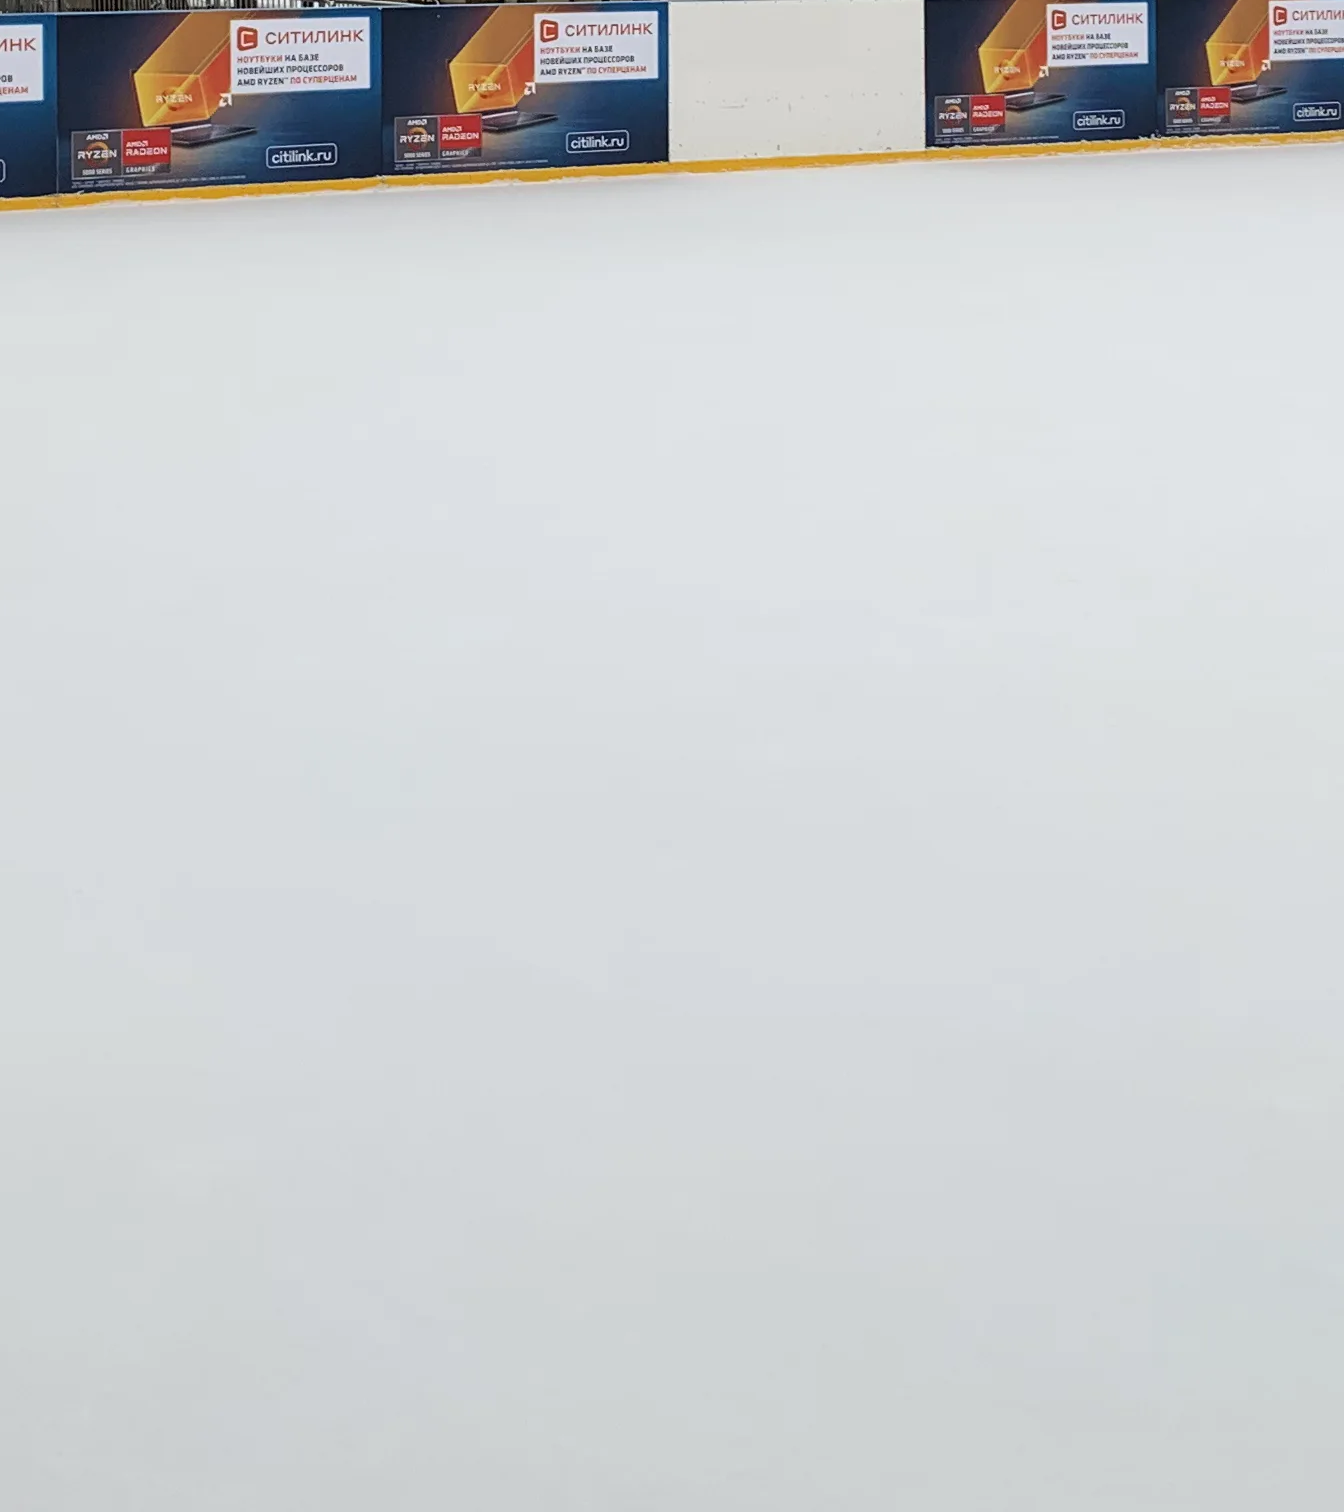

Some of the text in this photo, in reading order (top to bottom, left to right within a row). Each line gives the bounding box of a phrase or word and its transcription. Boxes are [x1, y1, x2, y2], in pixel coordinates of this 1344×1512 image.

[1072, 13, 1143, 25] СИТИЛИНК
[565, 23, 652, 36] СИТИЛИНК
[265, 29, 363, 44] СИТИЛИНК
[237, 55, 282, 63] НОУТБУКИ
[299, 53, 319, 61] БАЗЕ
[237, 64, 343, 74] НОВЕЙШИХ ПРОЦЕССОРОВ
[237, 78, 255, 86] AMD
[303, 74, 357, 84] СУПЕРЦЕНАМ
[468, 82, 500, 91] RYZEN
[155, 94, 192, 103] RYZEN
[1297, 106, 1336, 117] citilink.ru
[1077, 114, 1120, 126] citilink.ru
[400, 134, 434, 143] RYZEN
[442, 132, 478, 140] RADEON
[571, 135, 623, 148] citilink.ru
[77, 149, 116, 159] RYZEN
[125, 147, 167, 156] RADEON
[272, 148, 331, 163] citilink.ru
